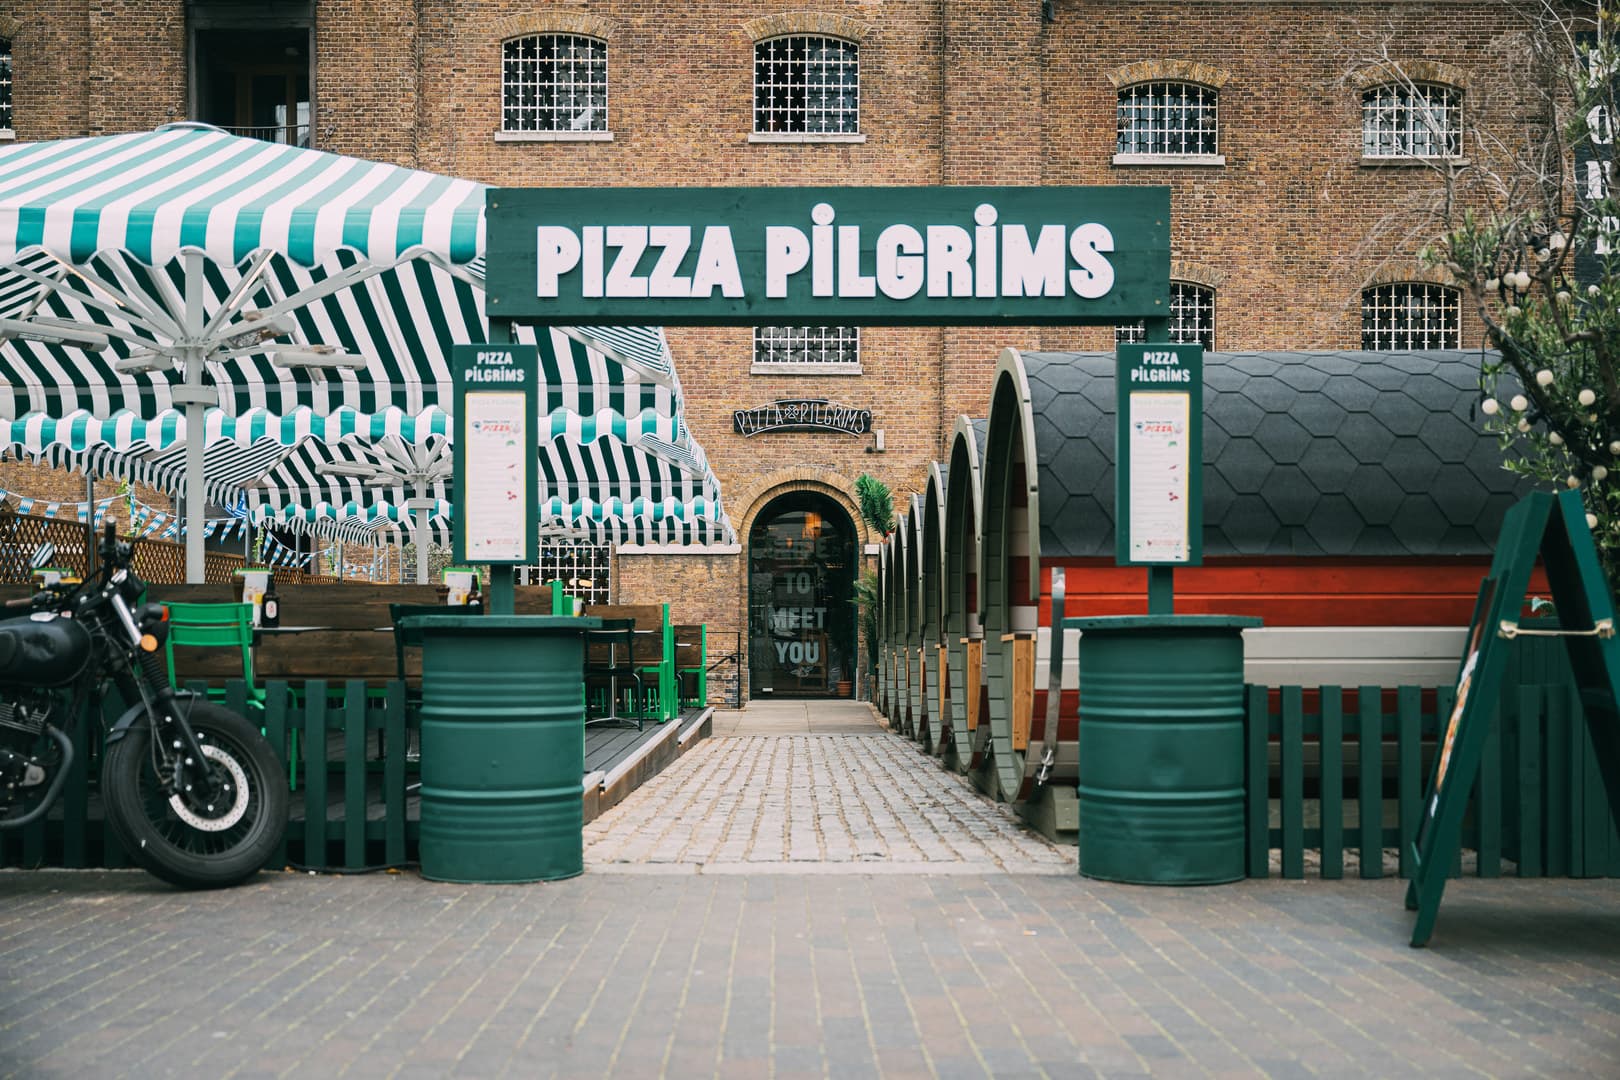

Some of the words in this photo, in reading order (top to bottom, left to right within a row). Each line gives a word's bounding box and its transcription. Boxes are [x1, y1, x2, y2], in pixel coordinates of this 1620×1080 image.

[537, 226, 745, 297] PIZZA
[477, 352, 513, 365] PIZZA
[1143, 352, 1179, 365] PIZZA
[735, 404, 784, 435] PIZZA
[800, 402, 870, 433] PILGRIMS
[783, 572, 811, 594] TO
[768, 607, 827, 629] MEET
[774, 641, 819, 664] YOU
